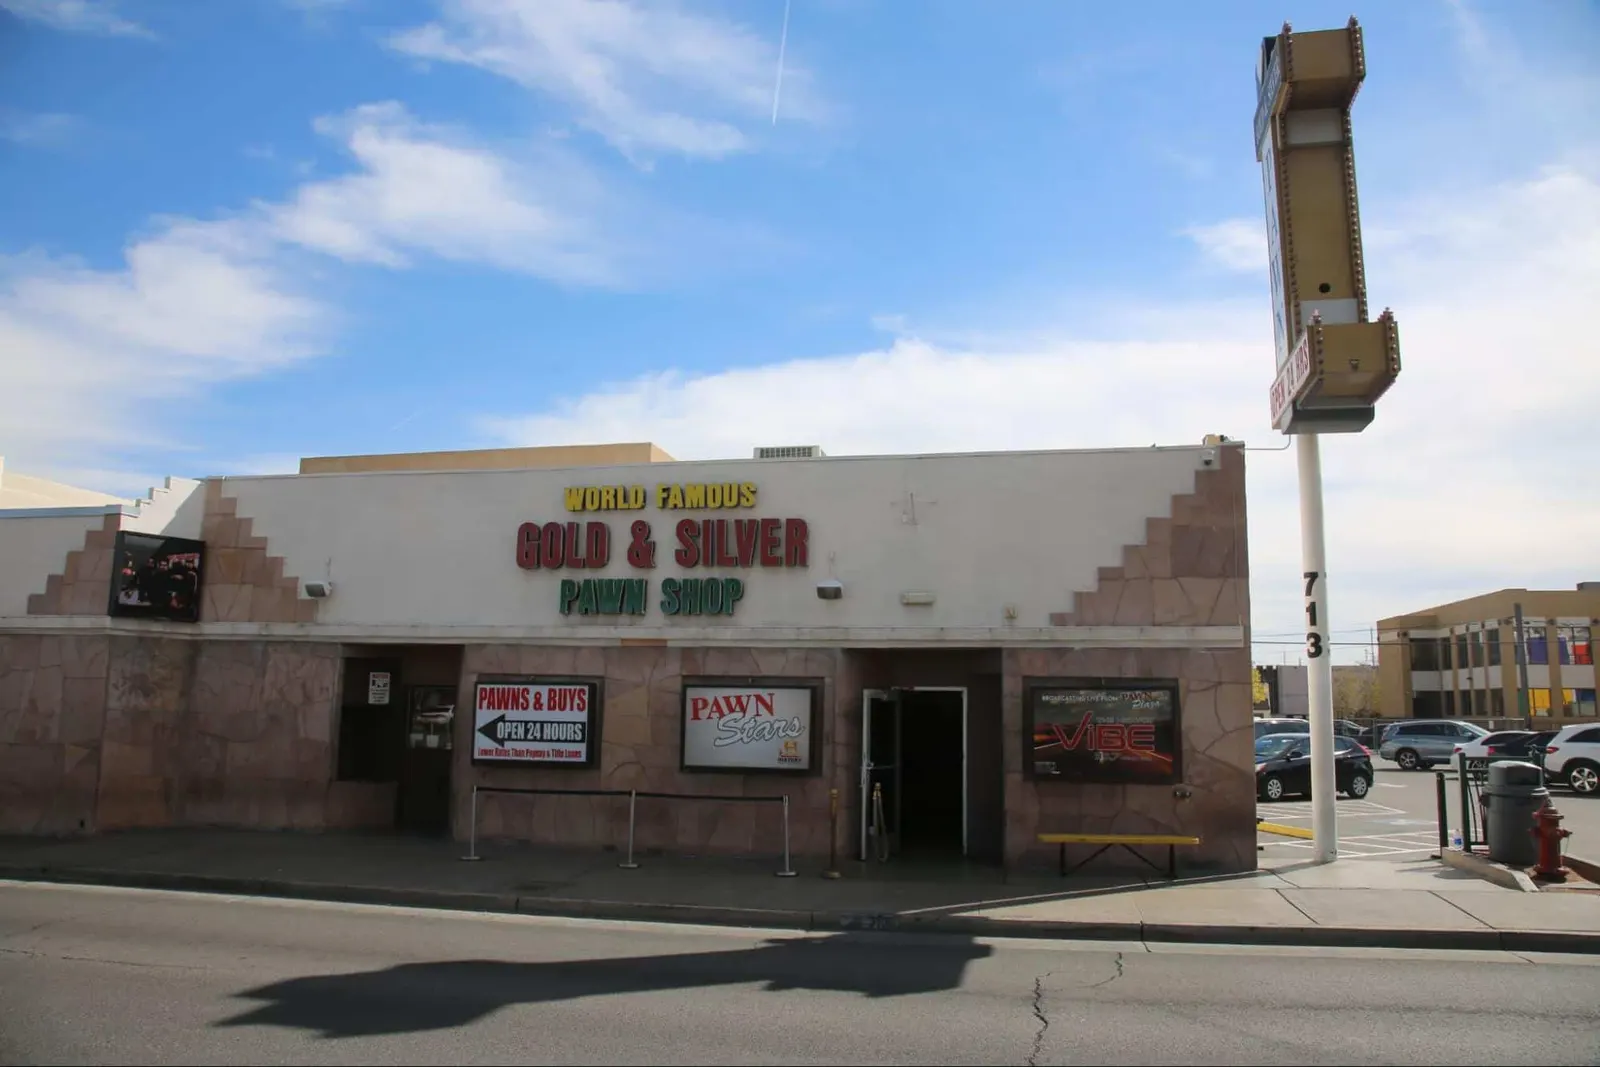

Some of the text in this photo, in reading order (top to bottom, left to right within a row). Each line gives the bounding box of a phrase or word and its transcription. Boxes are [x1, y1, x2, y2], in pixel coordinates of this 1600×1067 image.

[563, 482, 757, 512] WORLD FAMOUS
[516, 518, 810, 570] GOLD & SILVER
[559, 577, 744, 616] PAWN SHOP
[1303, 571, 1322, 658] 713
[478, 687, 587, 712] PAWNS & BUYS
[690, 693, 775, 720] PAWN
[497, 721, 582, 740] OPEN 24 HOURS
[713, 712, 806, 747] Stars
